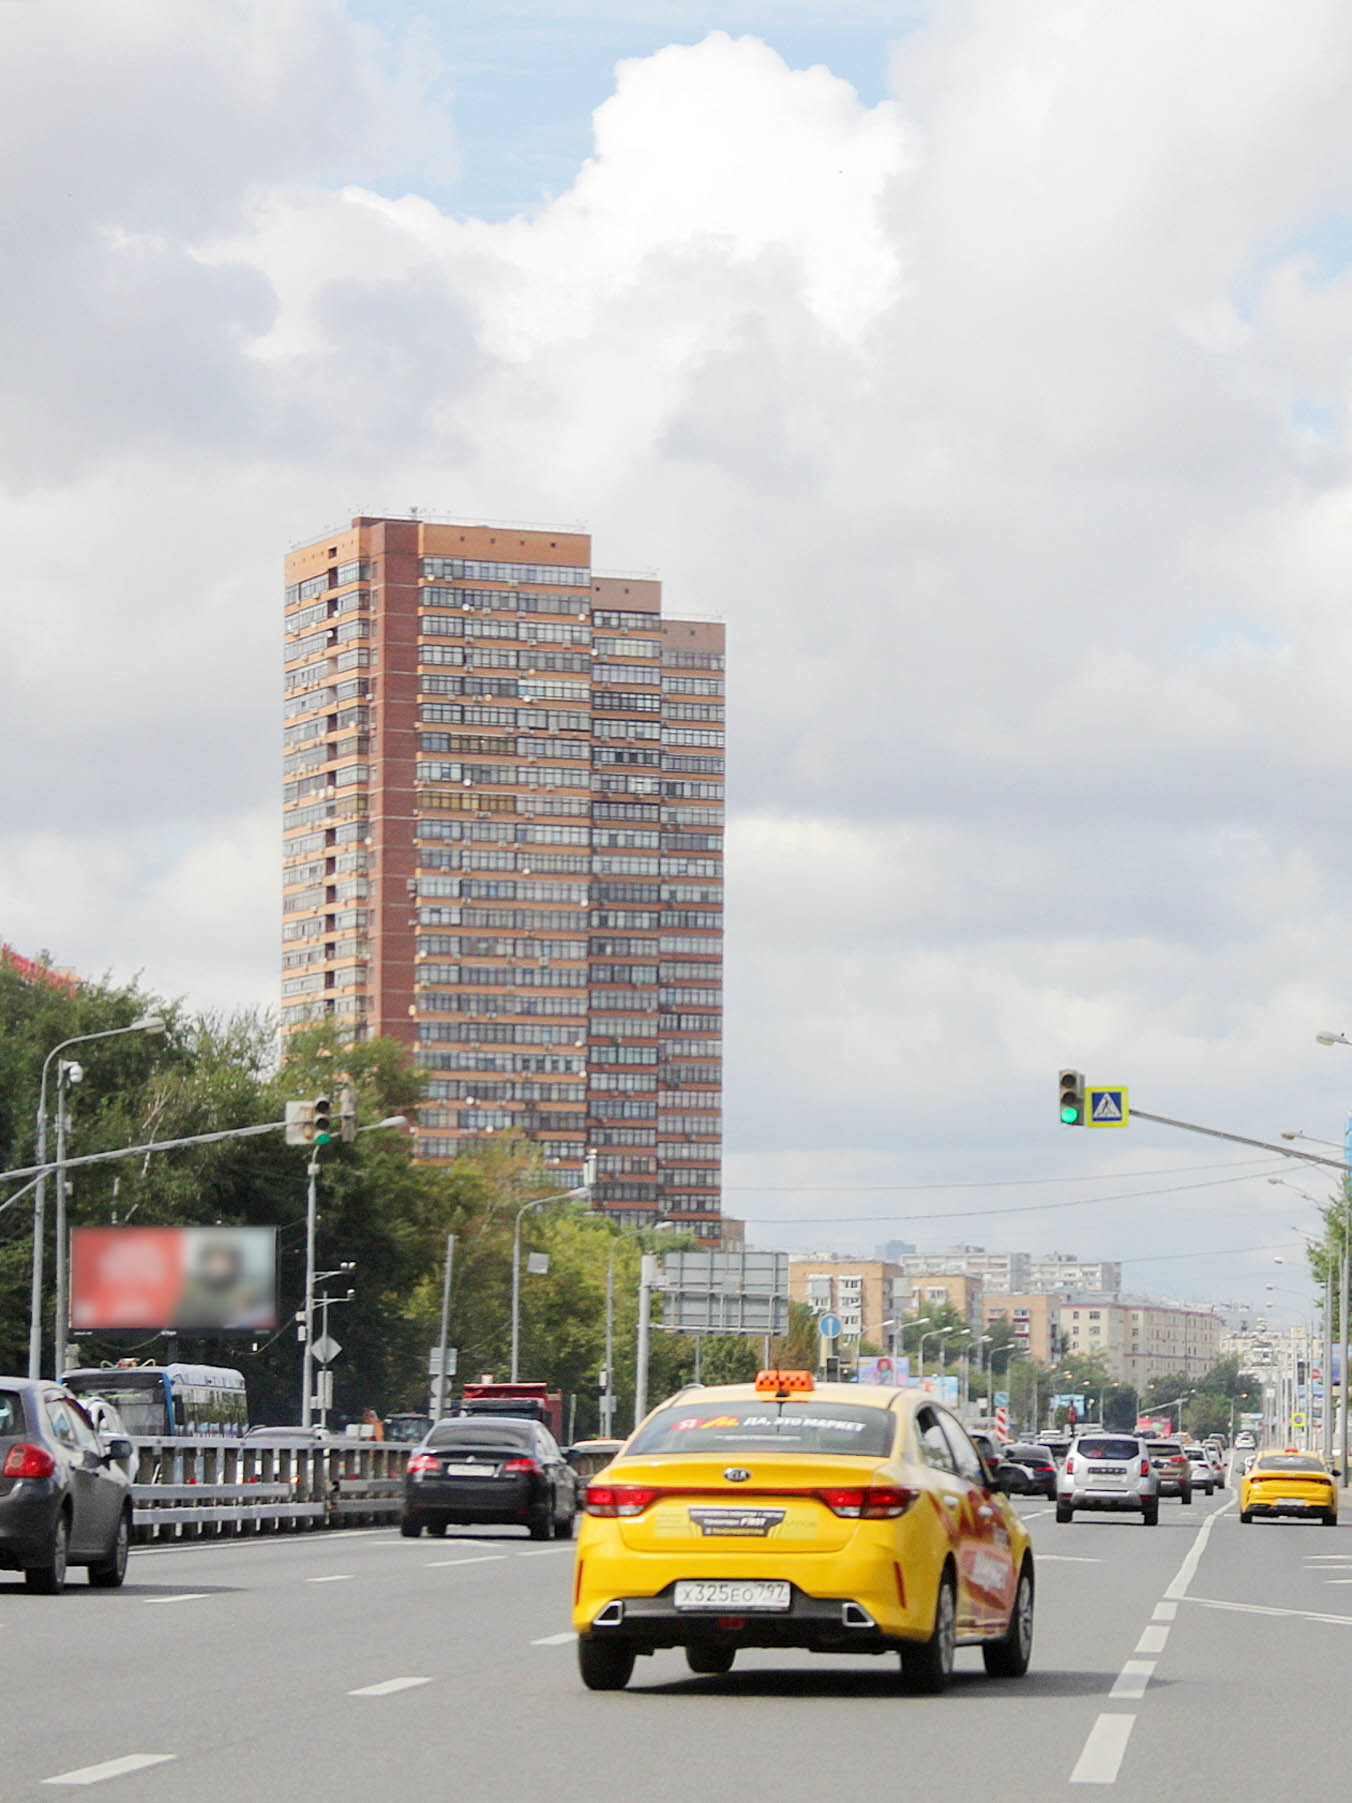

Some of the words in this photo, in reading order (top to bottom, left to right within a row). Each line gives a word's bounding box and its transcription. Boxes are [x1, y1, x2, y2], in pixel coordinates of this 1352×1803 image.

[743, 1416, 770, 1427] ДА,
[774, 1416, 802, 1426] ЭТО
[803, 1417, 867, 1432] МАРКЕТ
